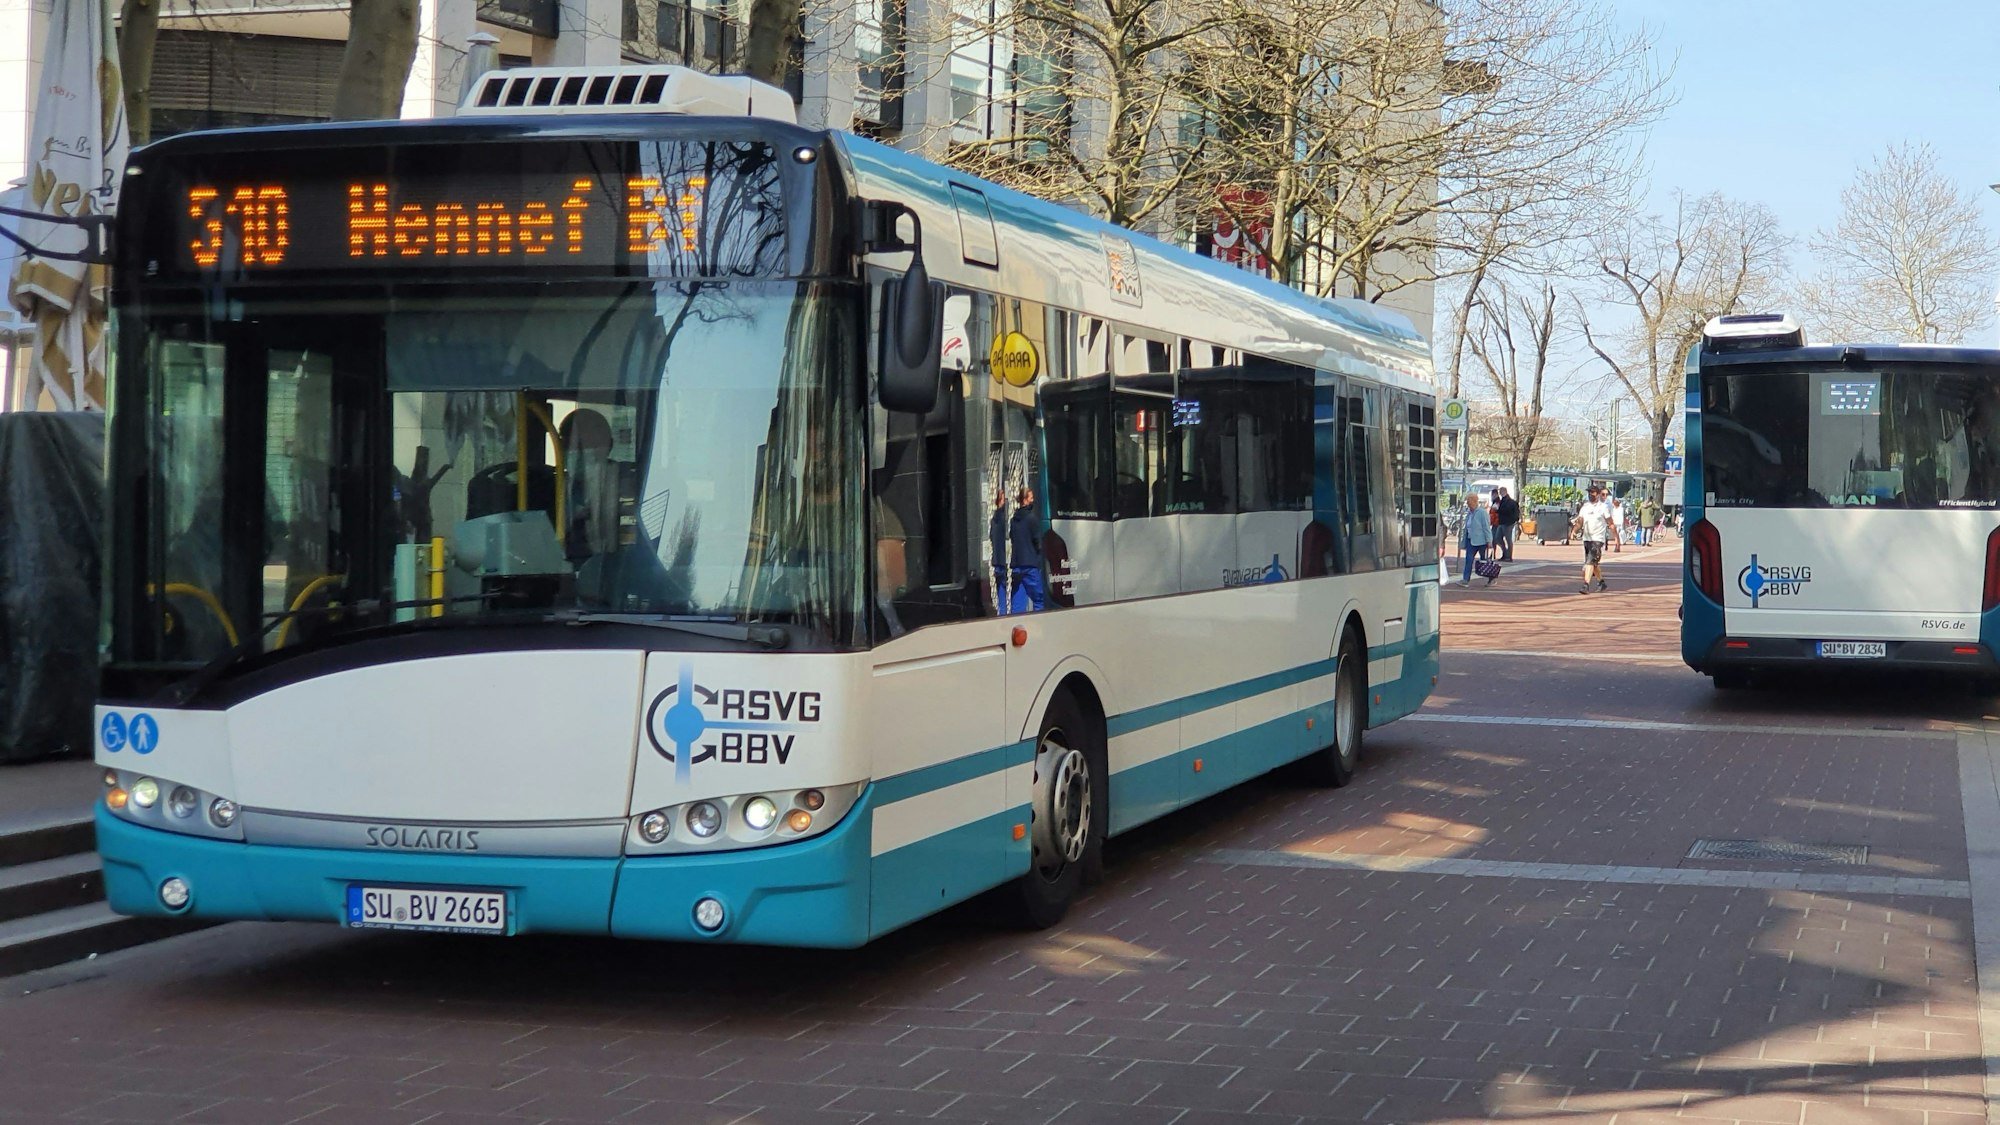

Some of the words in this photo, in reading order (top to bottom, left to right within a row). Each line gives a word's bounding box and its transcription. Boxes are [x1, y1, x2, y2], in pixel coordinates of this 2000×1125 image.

[189, 187, 289, 264] 510
[349, 179, 593, 256] Hennef
[628, 178, 707, 252] Bf
[1829, 494, 1877, 505] MAN
[1938, 499, 1997, 507] EfficientHybrid
[1770, 566, 1811, 580] RSVG
[1770, 582, 1801, 596] BBV
[1921, 619, 1966, 630] RSVG.de
[1822, 643, 1837, 655] SU
[1842, 643, 1856, 655] BV
[1858, 643, 1884, 655] 2834
[721, 689, 821, 722] RSVG
[720, 732, 795, 765] BBV
[366, 826, 480, 850] SOLARIS
[365, 892, 392, 919] SU
[410, 894, 437, 921] BV
[444, 896, 500, 924] 2665
